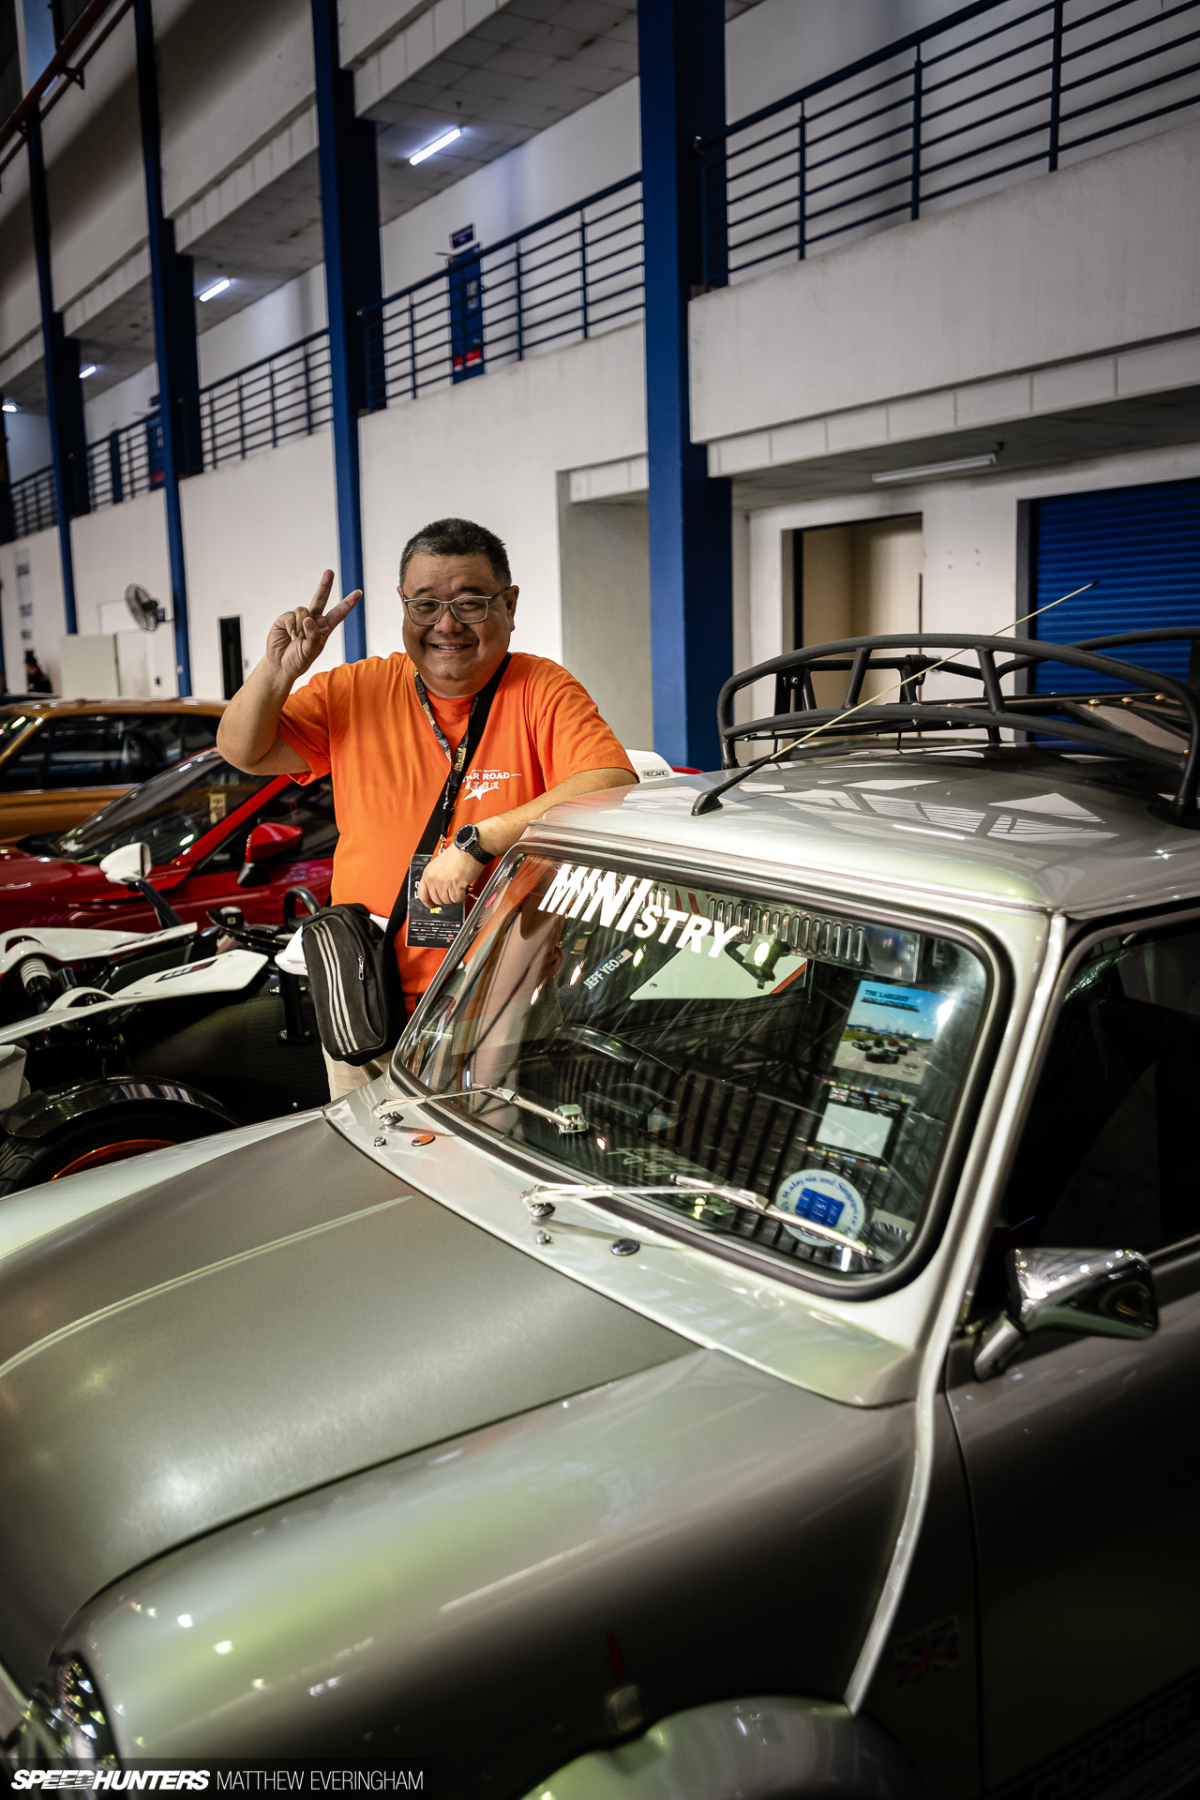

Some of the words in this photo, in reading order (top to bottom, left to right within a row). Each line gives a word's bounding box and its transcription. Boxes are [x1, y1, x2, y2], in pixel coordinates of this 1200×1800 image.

[482, 771, 511, 780] ROAD
[538, 863, 743, 958] MINISTRY
[583, 970, 604, 990] JEFF
[599, 959, 620, 975] YEO
[782, 1175, 817, 1199] Malaysia
[820, 1177, 836, 1187] and
